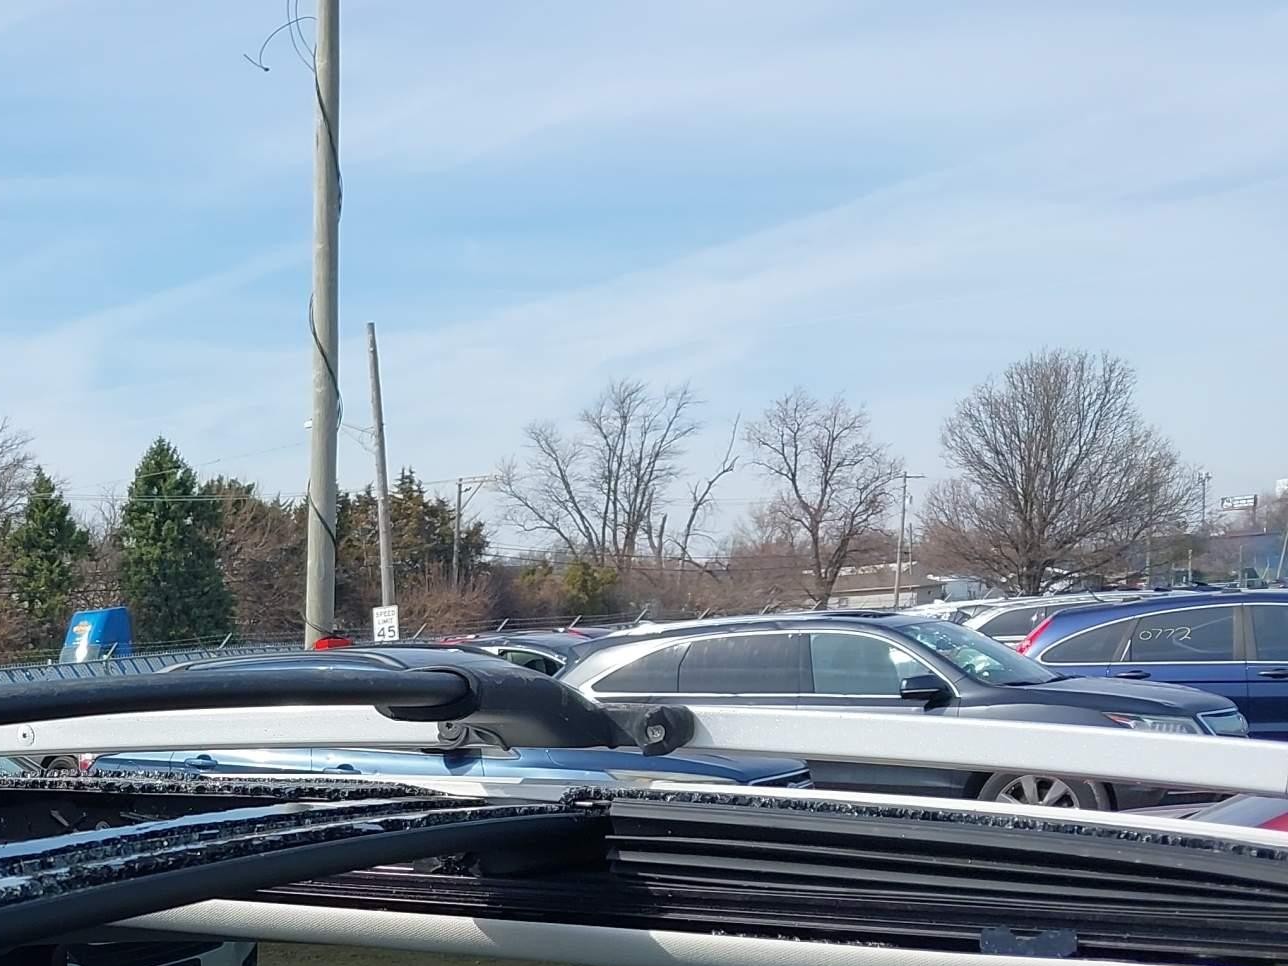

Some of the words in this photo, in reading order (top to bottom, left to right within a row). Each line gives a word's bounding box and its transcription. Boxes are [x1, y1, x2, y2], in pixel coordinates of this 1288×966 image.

[375, 610, 395, 618] SPEED
[377, 617, 393, 625] LIMIT
[377, 625, 396, 639] 45
[1139, 627, 1191, 640] 0772
